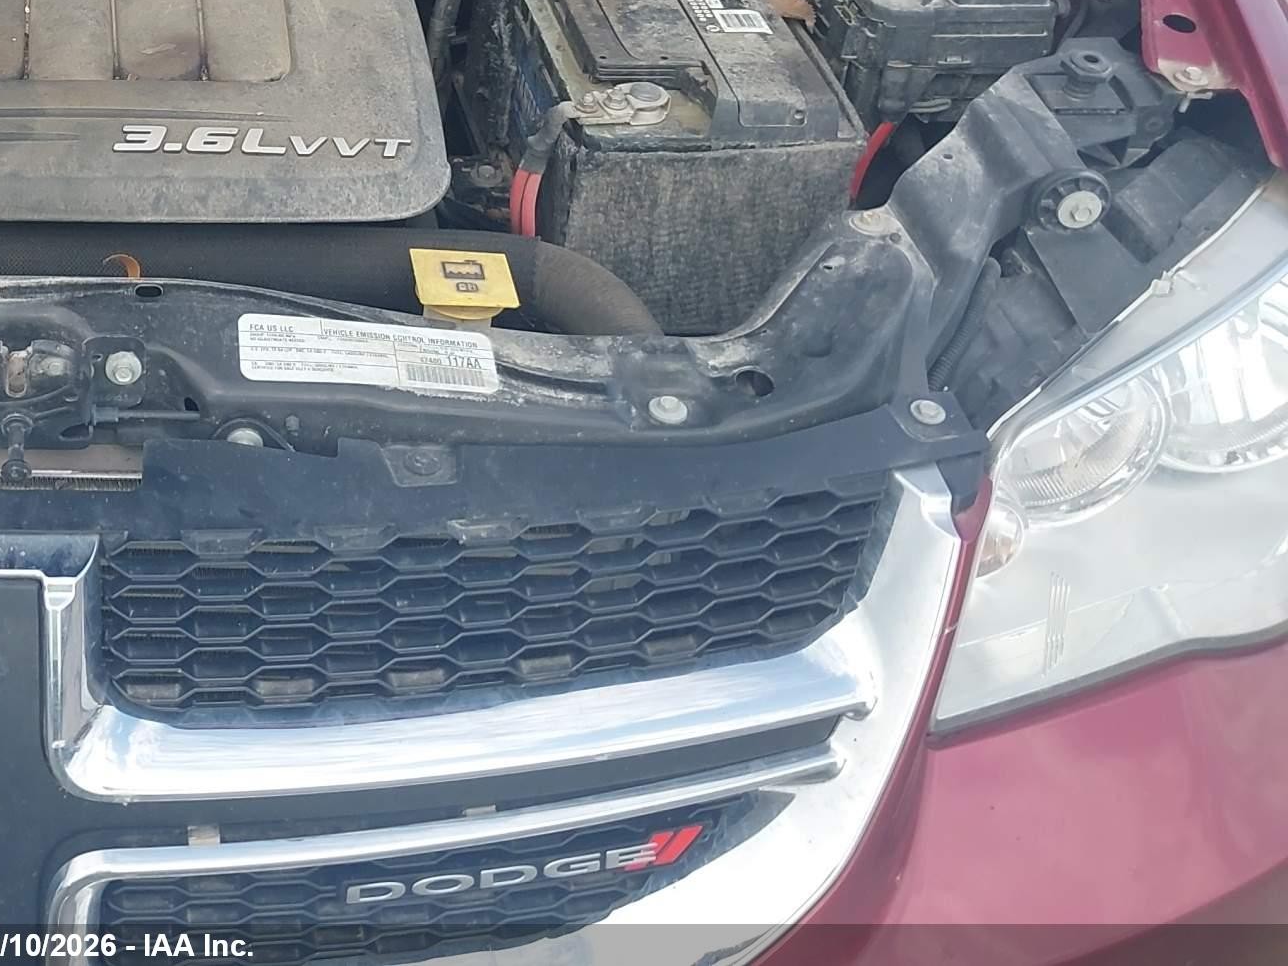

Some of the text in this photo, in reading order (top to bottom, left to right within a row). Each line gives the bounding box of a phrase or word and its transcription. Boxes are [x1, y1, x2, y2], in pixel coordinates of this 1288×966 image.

[112, 124, 412, 158] 3.6L VVT
[249, 323, 294, 333] FCA US LLC
[323, 328, 354, 337] VEHICLE
[356, 330, 391, 340] EMISSION
[392, 334, 425, 344] CONTROL
[427, 337, 479, 348] INFORMATION
[345, 842, 659, 905] DODGE
